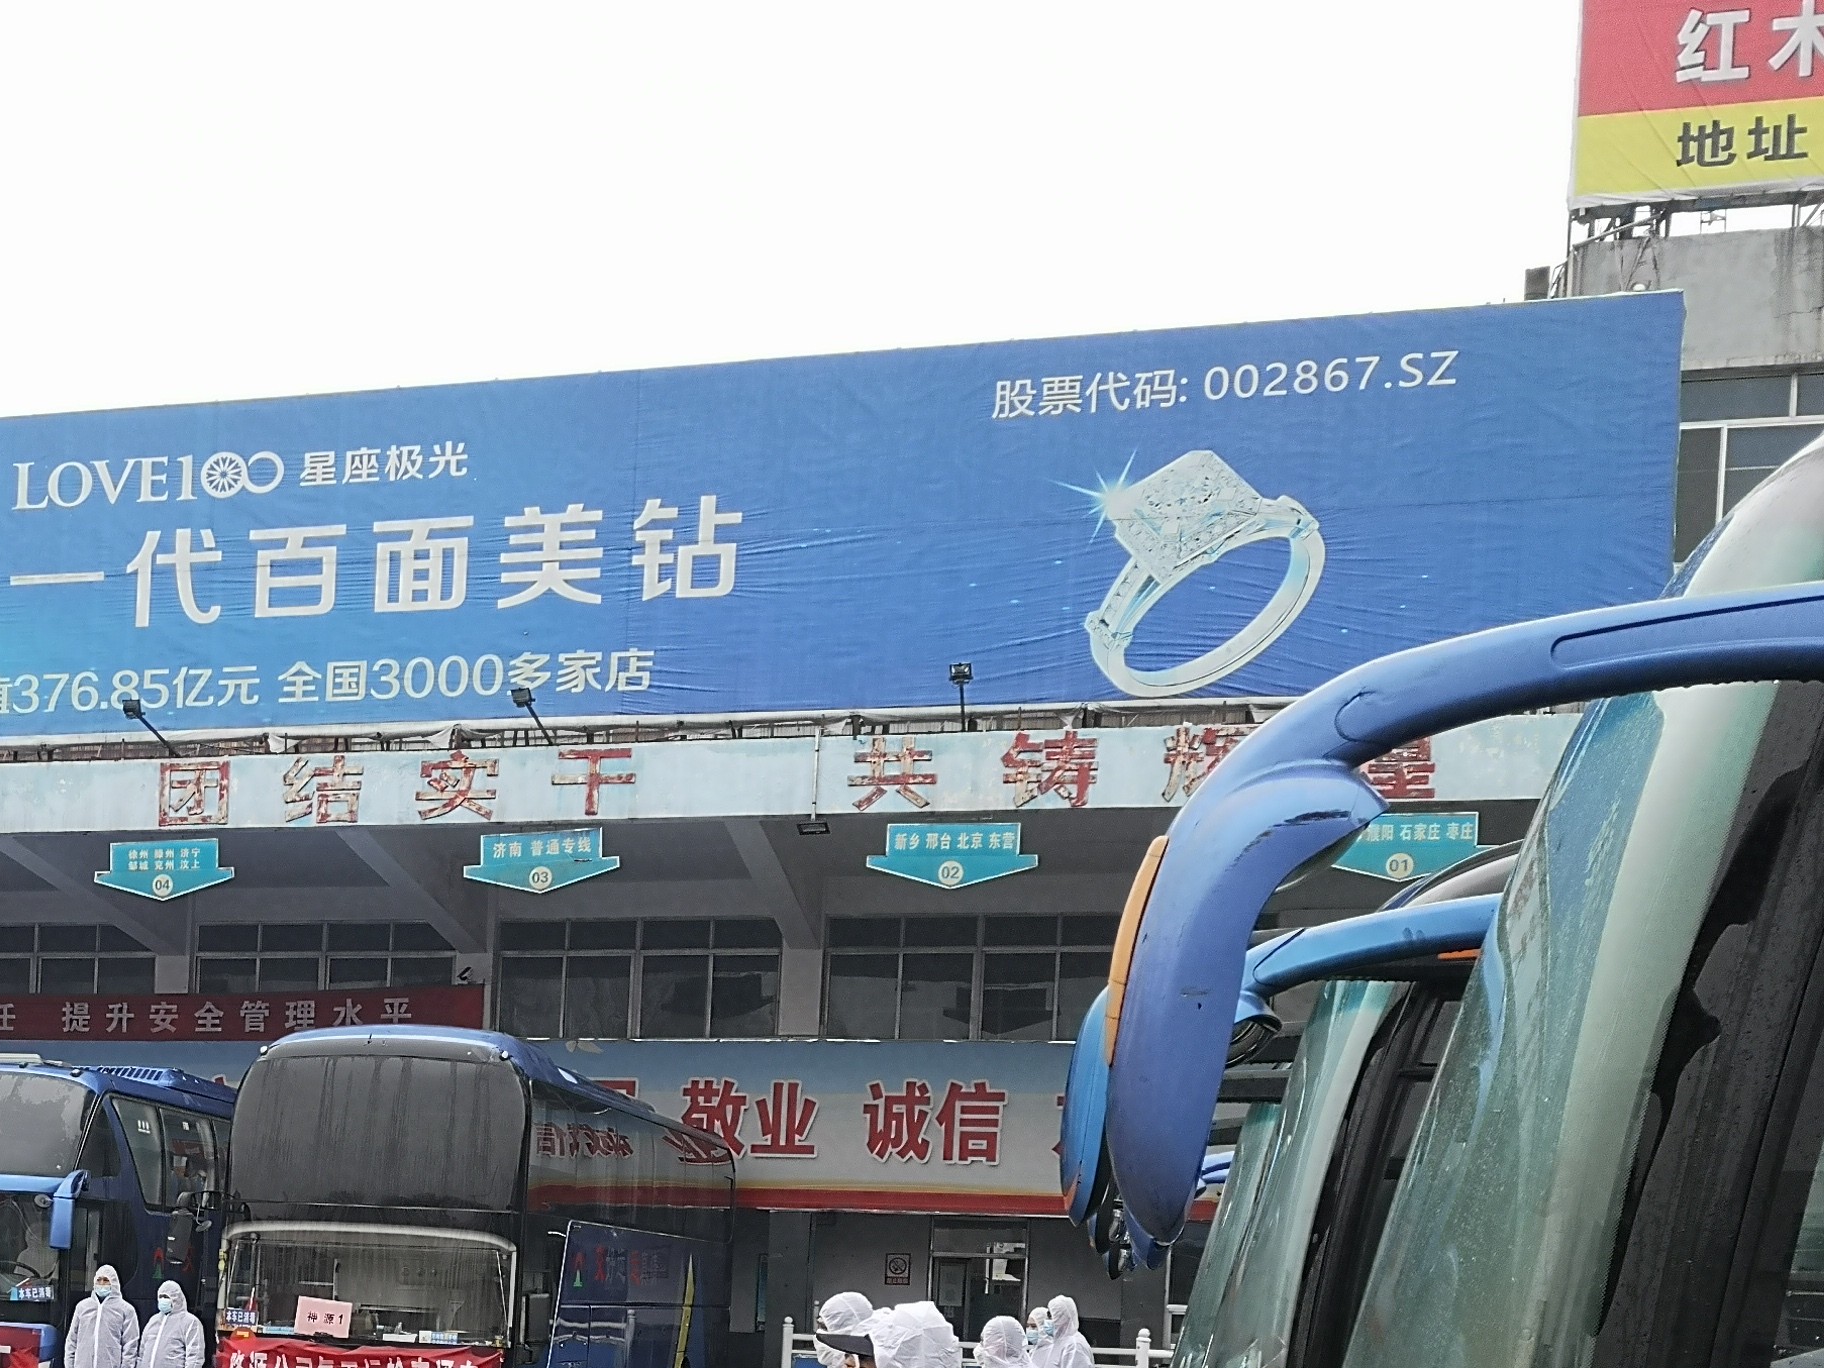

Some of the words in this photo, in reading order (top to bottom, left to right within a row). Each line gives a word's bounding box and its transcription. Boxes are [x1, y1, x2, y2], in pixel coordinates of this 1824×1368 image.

[1676, 0, 1824, 83] 红木
[1676, 114, 1808, 167] 地址
[1204, 350, 1459, 402] 002867.SZ
[299, 440, 468, 487] 星座极光
[278, 647, 655, 706] 全国3000多家店
[158, 747, 637, 828] 团结实干
[492, 841, 522, 859] 济南
[530, 836, 592, 857] 普通专线
[894, 832, 920, 850] 新乡
[925, 832, 951, 850] 邢台
[957, 832, 983, 849] 北京
[988, 831, 1016, 849] 东营
[1399, 823, 1441, 842] 石家庄
[1446, 822, 1474, 841] 枣庄
[531, 871, 549, 884] 03
[941, 865, 960, 879] 02
[1389, 859, 1409, 872] 01
[154, 878, 170, 891] 04
[61, 997, 413, 1034] 提升安全管理水平
[680, 1078, 819, 1161] 敬业
[863, 1079, 1008, 1164] 诚信
